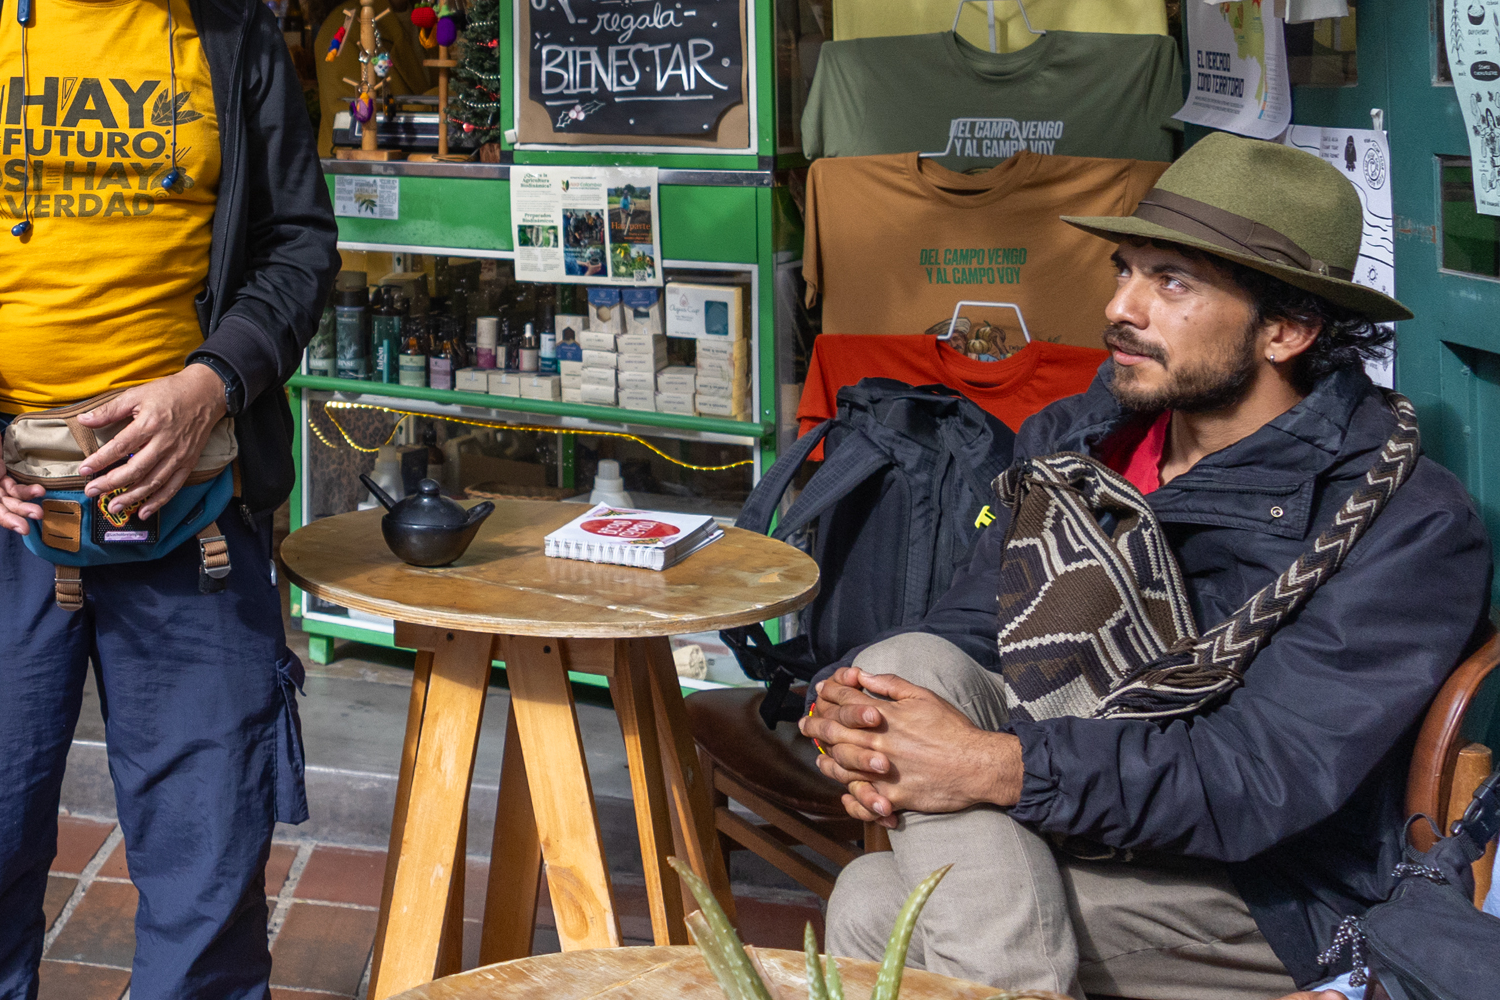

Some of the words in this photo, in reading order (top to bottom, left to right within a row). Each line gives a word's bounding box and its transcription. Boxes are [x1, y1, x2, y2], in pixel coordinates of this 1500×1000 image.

[590, 2, 682, 44] regala
[541, 39, 728, 94] BIENESTAR
[5, 76, 161, 129] HAY
[2, 128, 166, 159] FUTURO
[949, 119, 971, 138] DEL
[974, 121, 1020, 139] CAMPO
[1021, 121, 1064, 139] VENGO
[954, 139, 962, 157] Y
[964, 139, 980, 157] AL
[982, 140, 1028, 158] CAMPO
[1029, 140, 1056, 156] VOY
[3, 158, 44, 192] SI
[62, 160, 164, 191] HAY
[4, 191, 155, 219] VERDAD
[919, 249, 941, 265] DEL
[943, 248, 986, 265] CAMPO
[987, 248, 1027, 265] VENGO
[925, 267, 933, 284] Y
[936, 267, 951, 284] AL
[952, 267, 995, 284] CAMPO
[996, 267, 1021, 284] VOY
